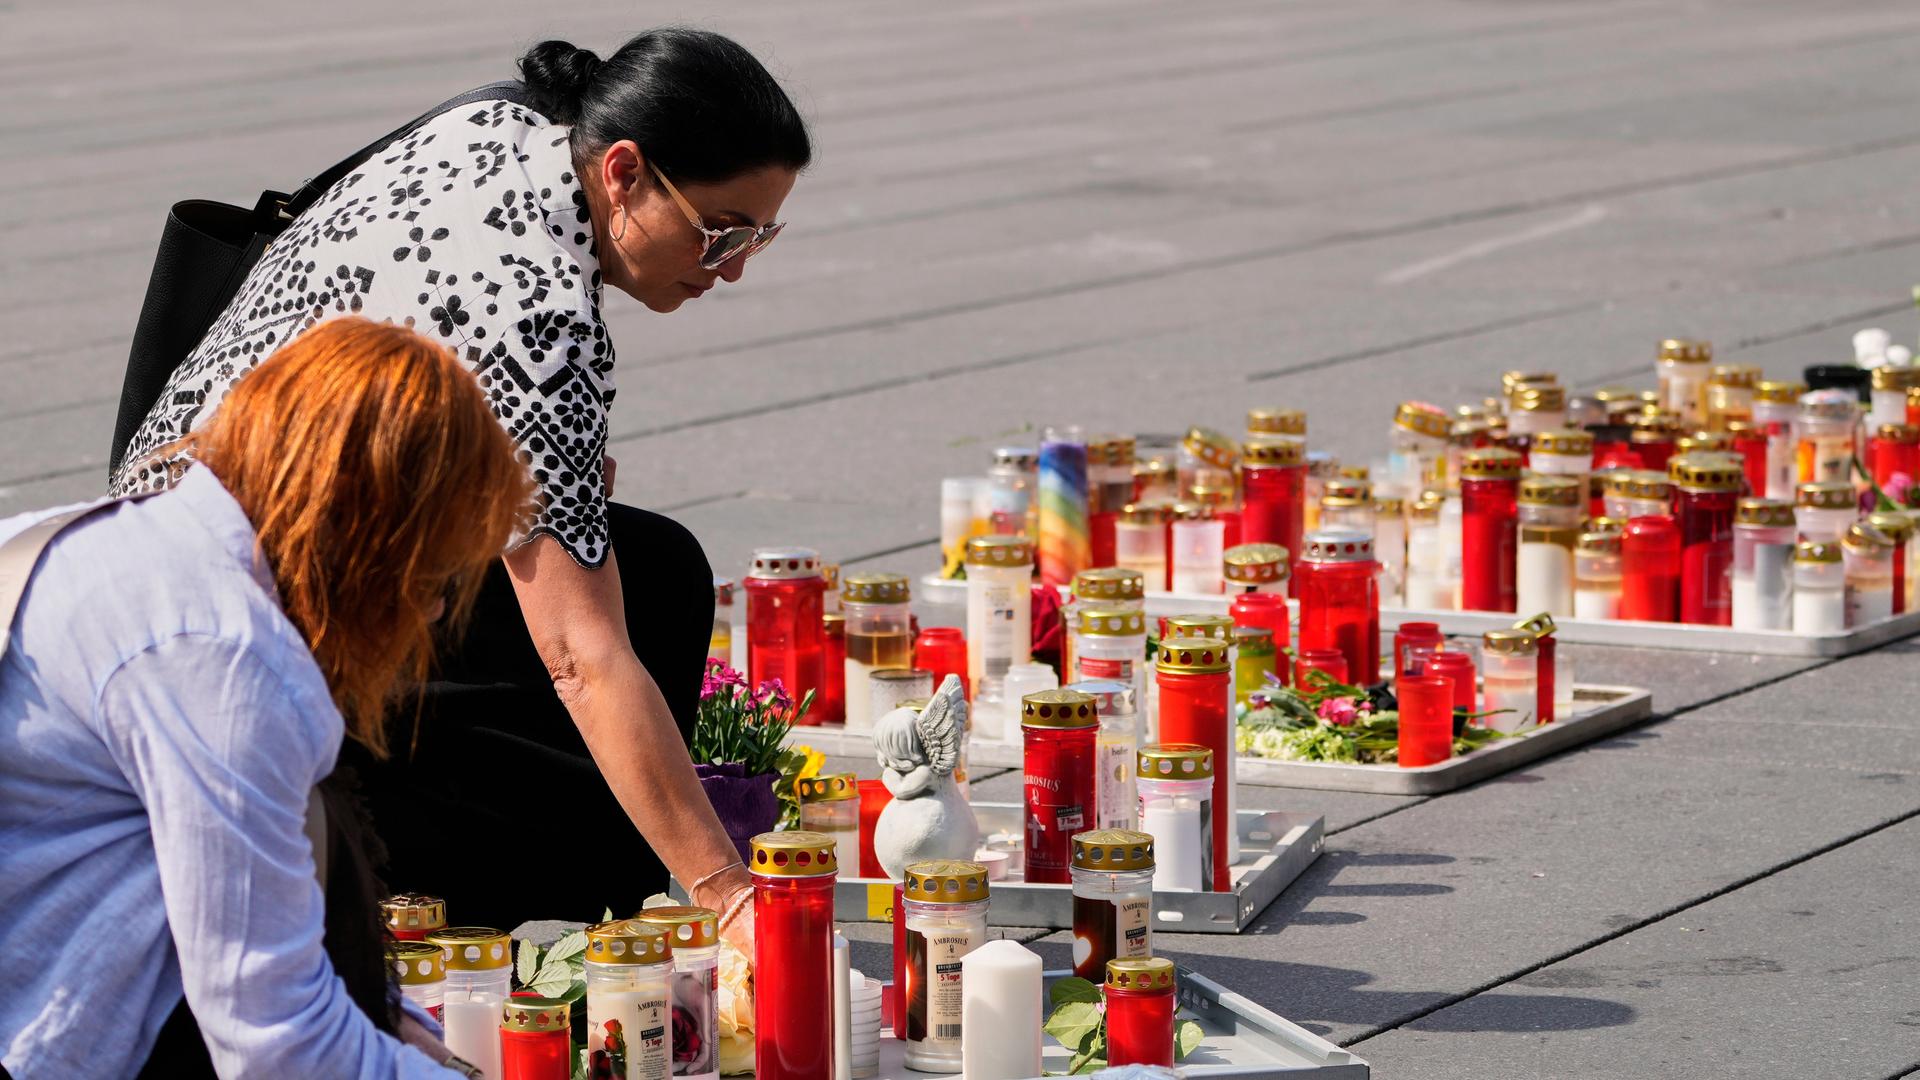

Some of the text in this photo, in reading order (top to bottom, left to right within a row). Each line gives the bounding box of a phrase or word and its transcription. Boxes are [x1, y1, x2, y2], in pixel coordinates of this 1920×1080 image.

[1024, 774, 1061, 792] BROSIUS
[933, 937, 969, 946] AMBROSIUS
[637, 1000, 667, 1011] AMBROSIUS
[646, 1039, 650, 1047] 5
